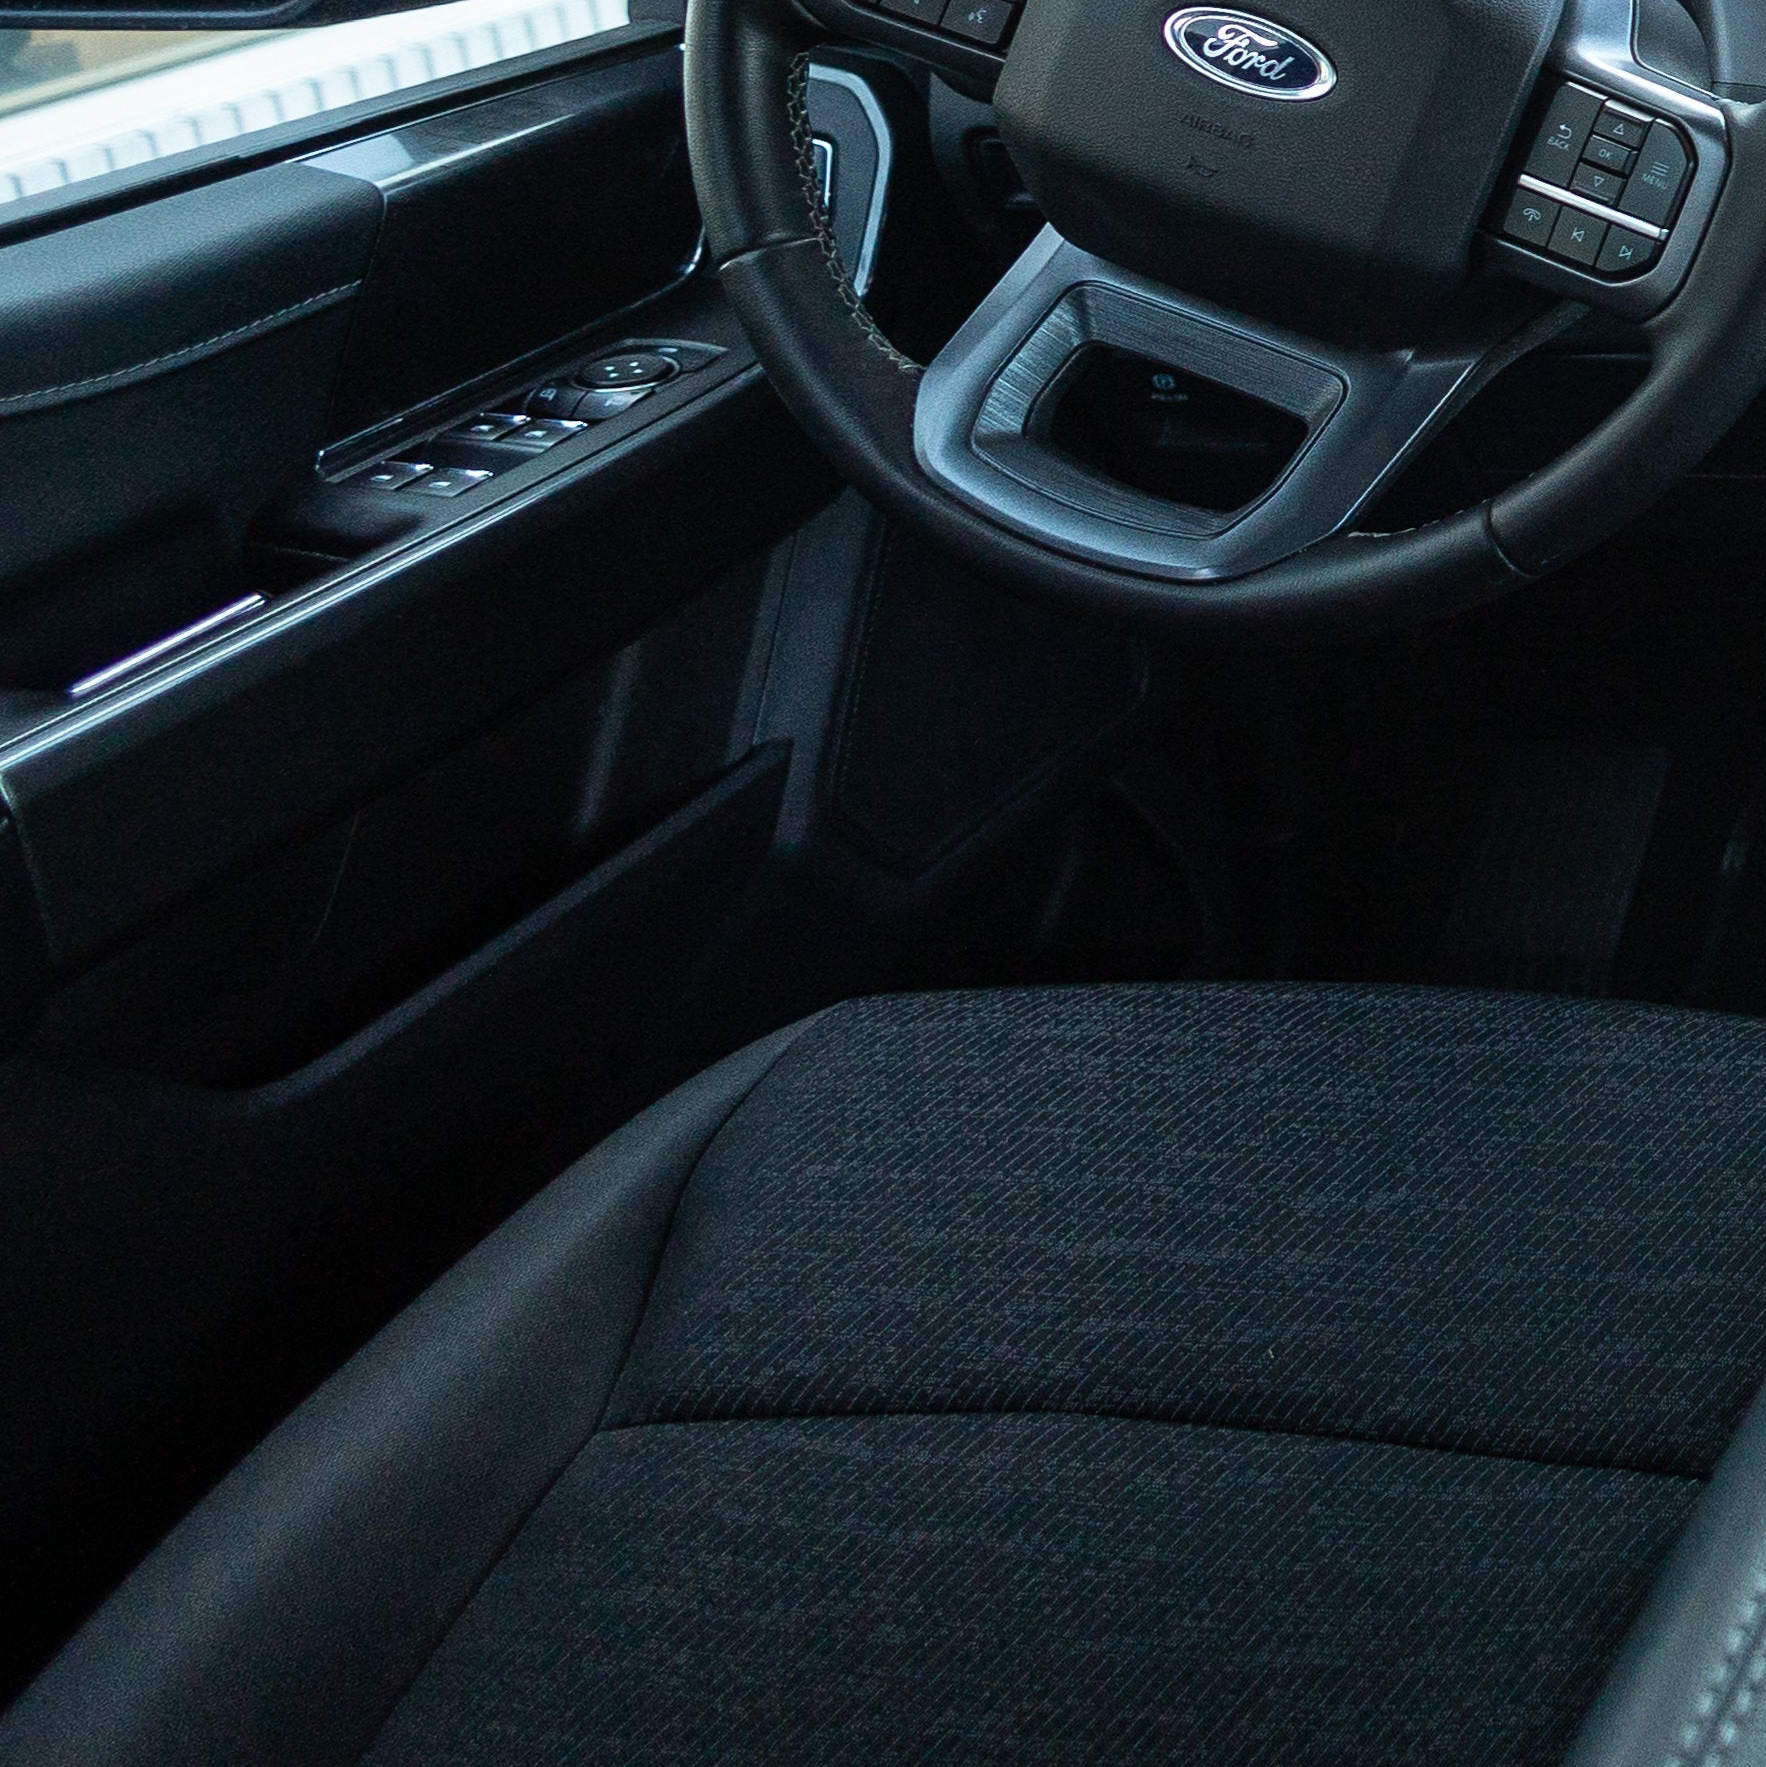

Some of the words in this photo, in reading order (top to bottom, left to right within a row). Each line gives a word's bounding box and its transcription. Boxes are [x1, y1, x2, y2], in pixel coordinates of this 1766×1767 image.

[1203, 24, 1294, 80] Ford
[1599, 148, 1614, 159] OK
[1641, 173, 1668, 190] MENU
